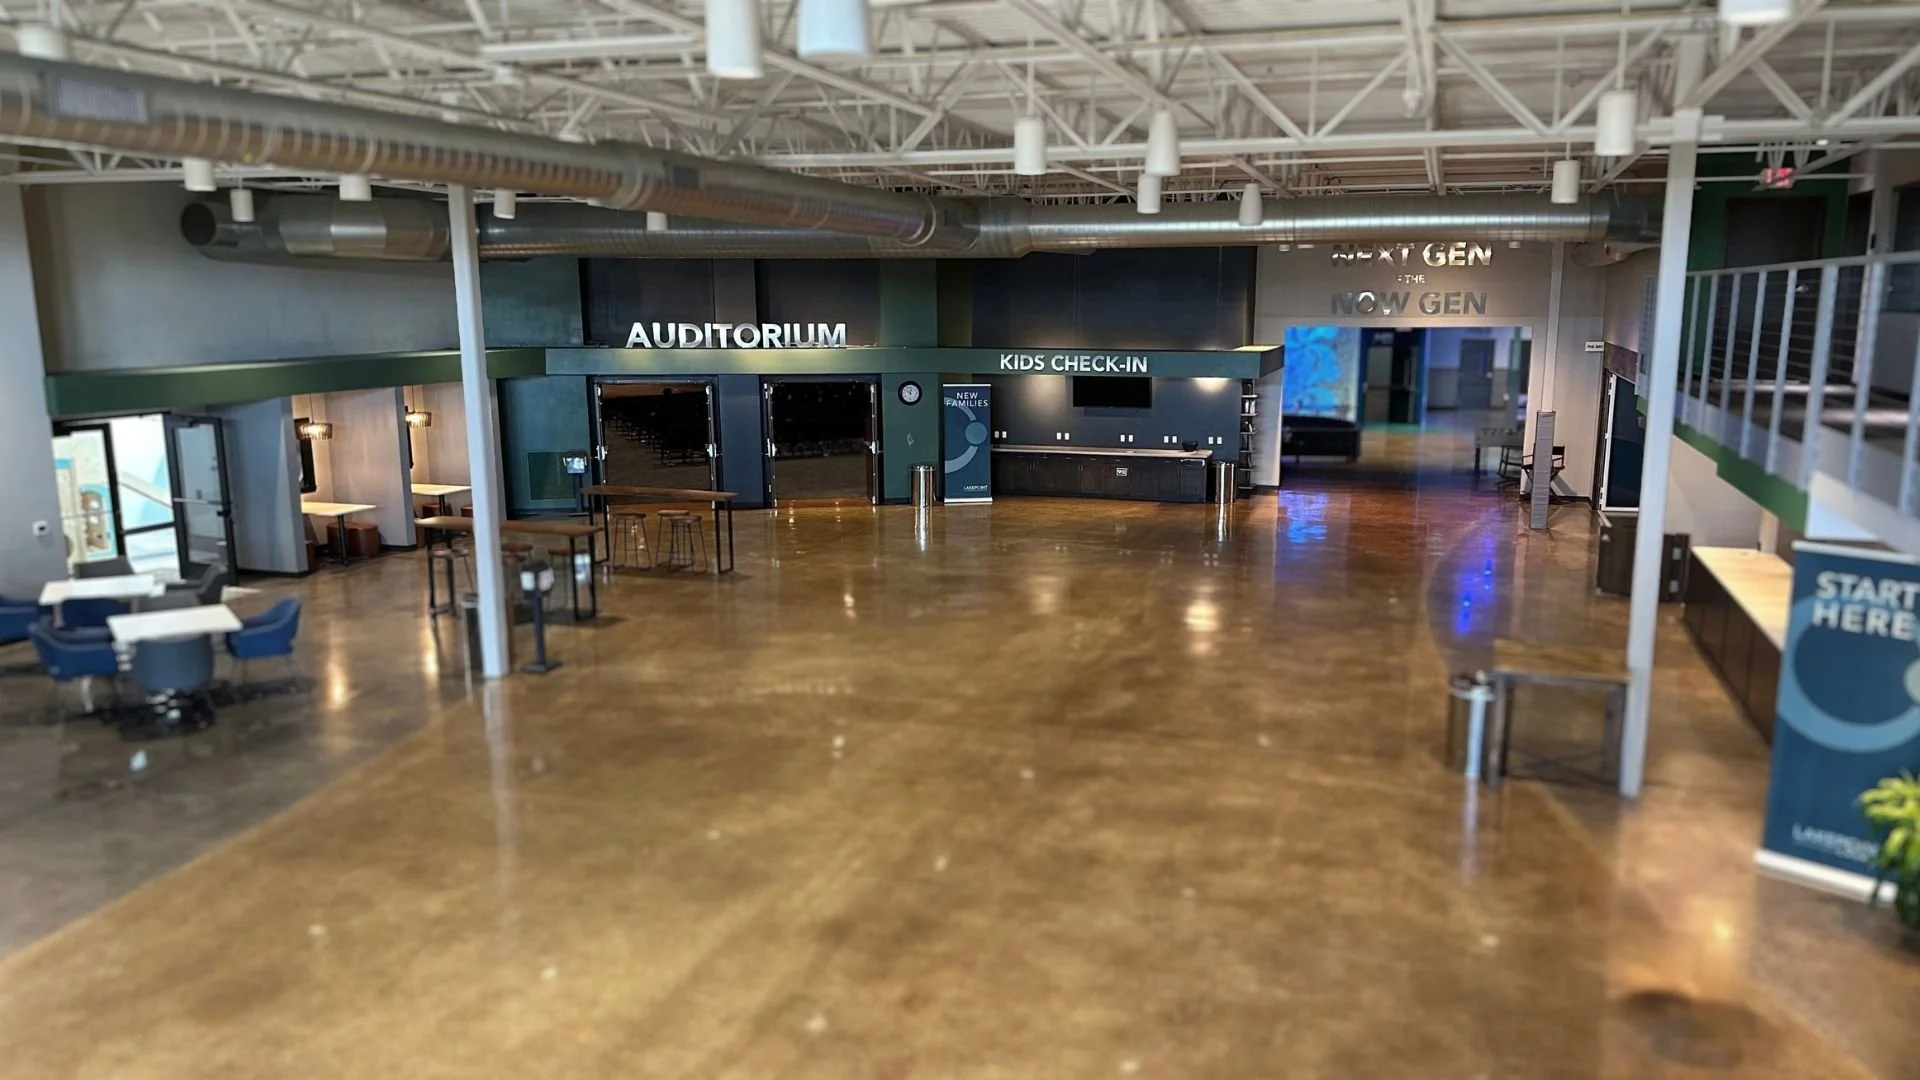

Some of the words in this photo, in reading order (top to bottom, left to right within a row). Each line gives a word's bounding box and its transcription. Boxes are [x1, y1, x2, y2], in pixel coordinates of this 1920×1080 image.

[1331, 242, 1415, 267] NEXT
[1422, 241, 1493, 267] GEN
[1404, 274, 1426, 284] THE
[1331, 290, 1411, 316] NOW
[1418, 290, 1488, 315] GEN
[625, 321, 847, 349] AUDITORIUM
[1000, 353, 1045, 370] KIDS
[1050, 354, 1149, 374] CHECK-IN
[946, 399, 989, 408] FAMILIES
[956, 391, 979, 400] NEW
[1816, 570, 1920, 611] START
[1811, 599, 1917, 642] HERE
[1791, 822, 1880, 857] LAKEPOIN
